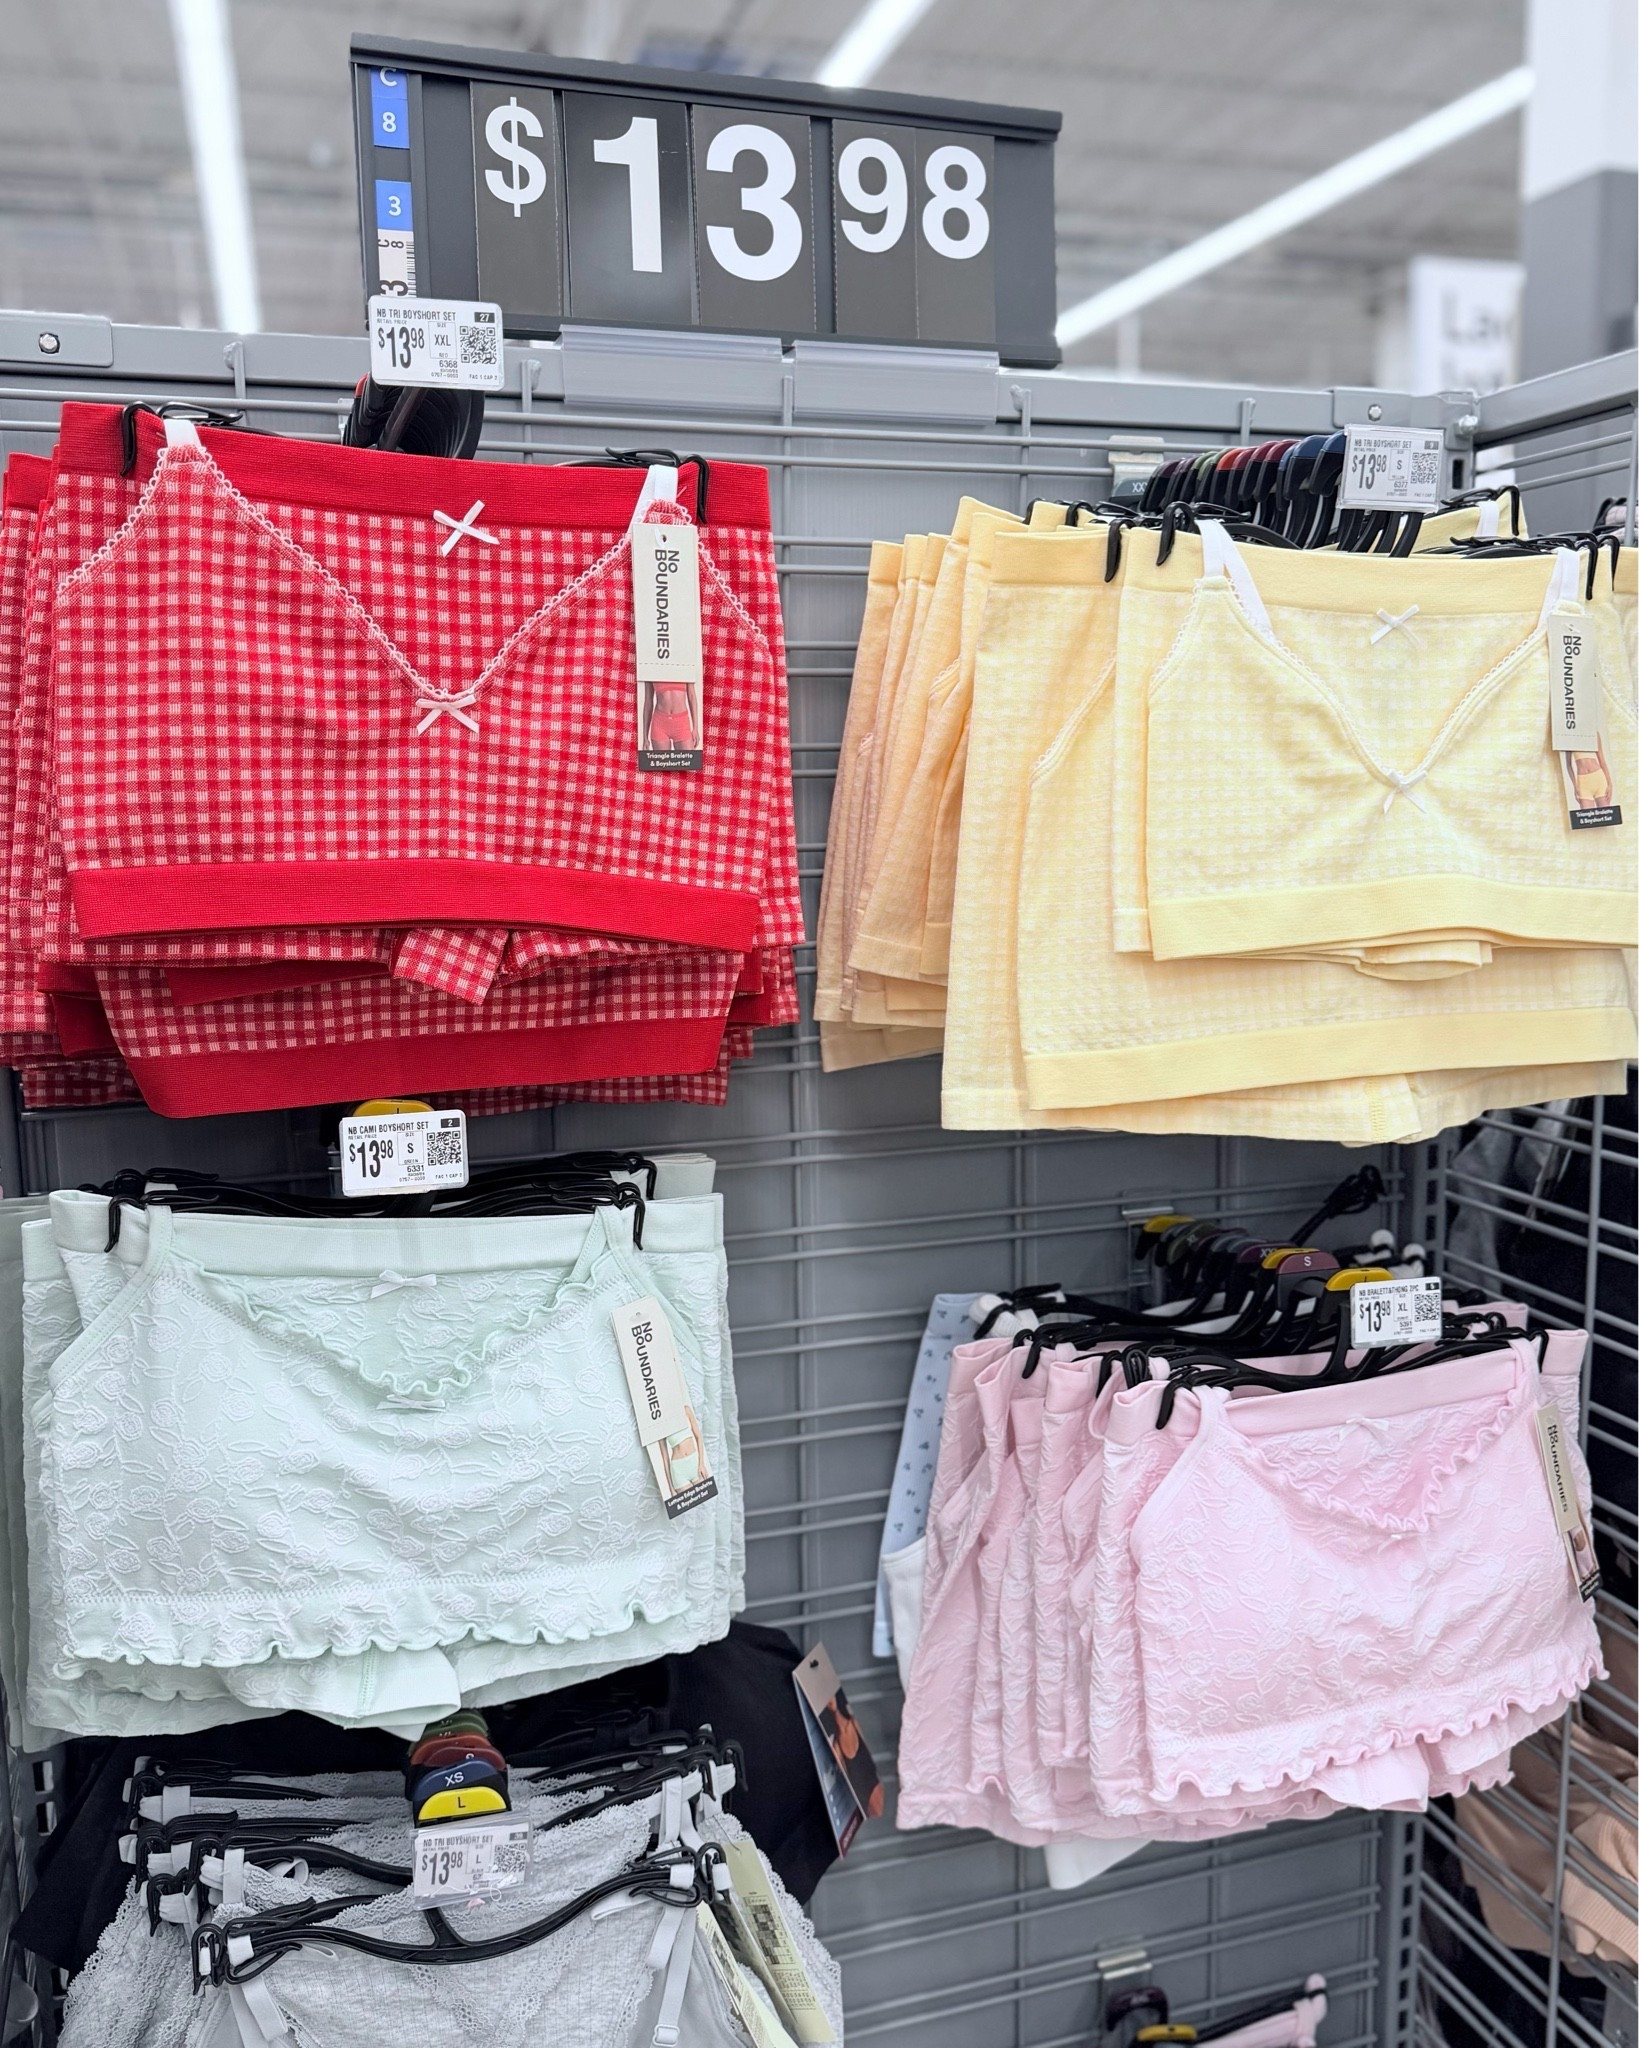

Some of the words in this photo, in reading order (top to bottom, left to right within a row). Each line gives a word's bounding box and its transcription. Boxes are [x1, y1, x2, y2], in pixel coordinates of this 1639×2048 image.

[382, 111, 397, 133] 8
[388, 195, 402, 216] 3
[377, 308, 386, 318] NB
[389, 308, 401, 319] TRI
[403, 309, 440, 321] BOYSHORT
[443, 311, 456, 321] SET
[479, 313, 490, 322] 27
[434, 334, 451, 347] XXL
[439, 359, 458, 369] 6368
[1396, 459, 1403, 470] S
[667, 549, 680, 574] NO
[654, 549, 671, 660] BOUNDARIES
[1572, 635, 1582, 656] NO
[1562, 635, 1577, 730] BOUNDARIES
[646, 752, 670, 760] Triangle
[655, 760, 681, 768] Boyshort
[348, 1126, 358, 1135] NB
[359, 1125, 377, 1134] CAMI
[378, 1122, 414, 1133] BOYSHORT
[416, 1121, 429, 1130] SET
[447, 1119, 453, 1127] 2
[407, 1142, 414, 1154] S
[406, 1164, 425, 1173] 6331
[1303, 1255, 1312, 1267] S
[1397, 1303, 1408, 1312] XL
[641, 1320, 653, 1343] NO
[631, 1326, 662, 1421] BOUNDARIES
[1547, 1426, 1569, 1513] BOUNDARIES
[445, 1771, 465, 1787] XS
[458, 1797, 466, 1808] L
[476, 1855, 481, 1864] L
